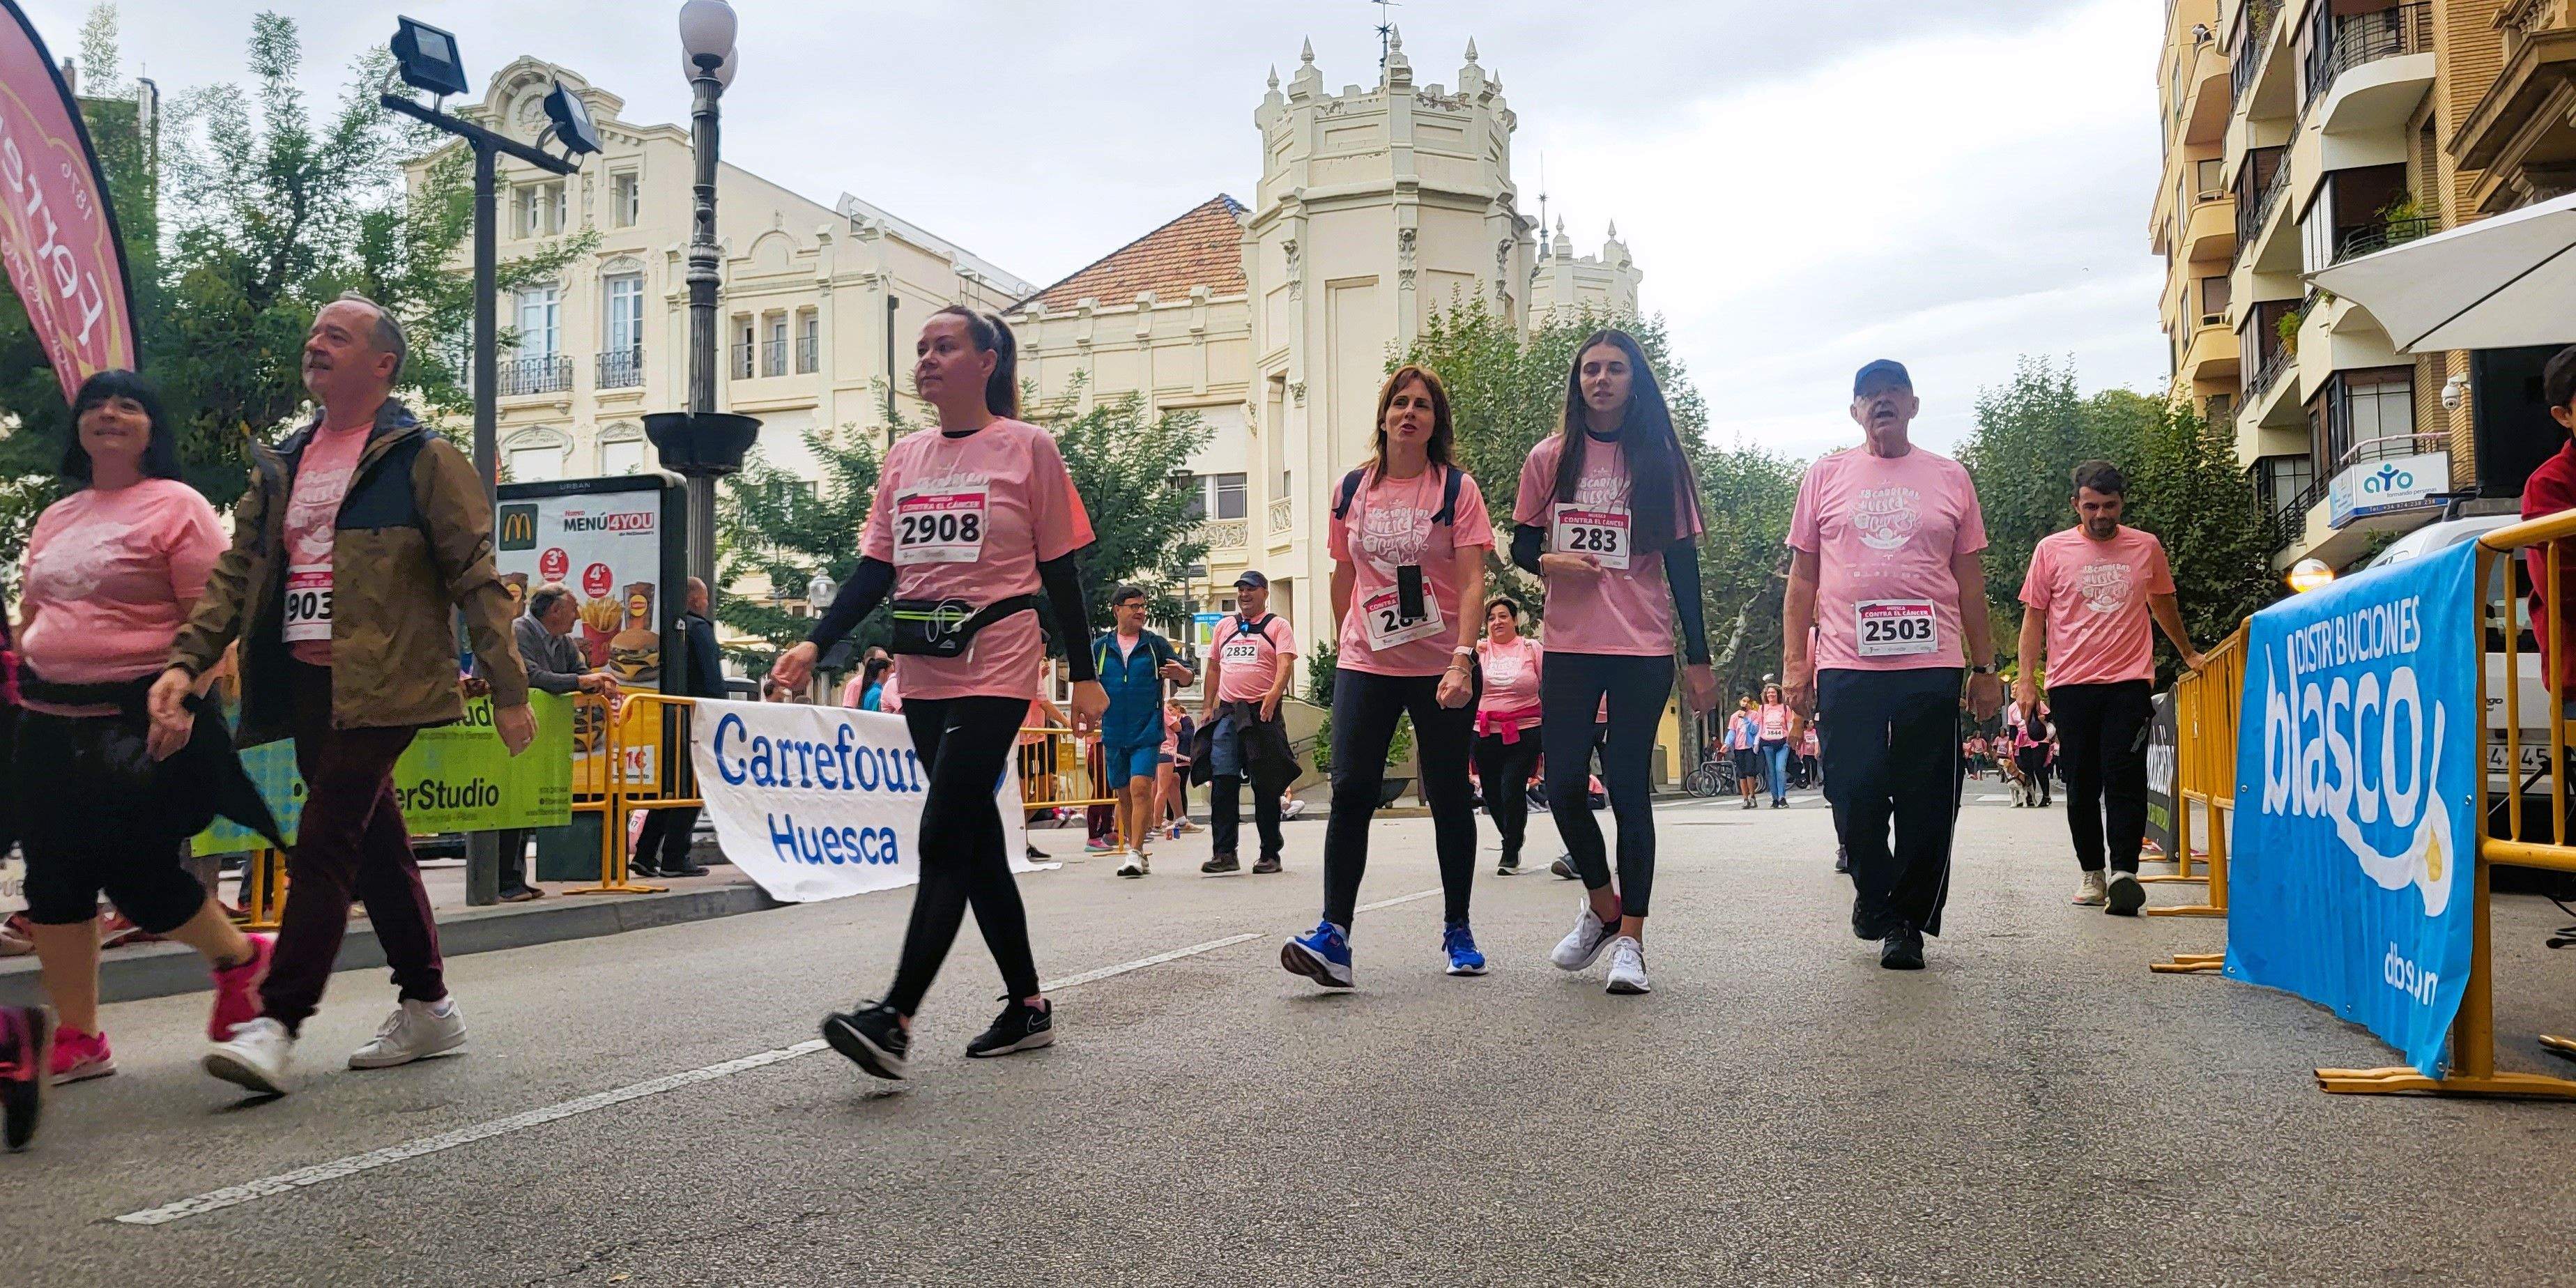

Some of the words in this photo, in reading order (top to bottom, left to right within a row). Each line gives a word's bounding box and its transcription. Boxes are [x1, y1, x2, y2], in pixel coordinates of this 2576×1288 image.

[901, 514, 980, 544] 2908
[1563, 516, 1593, 525] CONTRA
[1570, 527, 1617, 552] 283
[1864, 618, 1931, 642] 2503
[1227, 646, 1255, 657] 2832
[2262, 634, 2423, 828] blasco
[713, 712, 922, 793] Carrefour
[767, 813, 899, 866] Huesca
